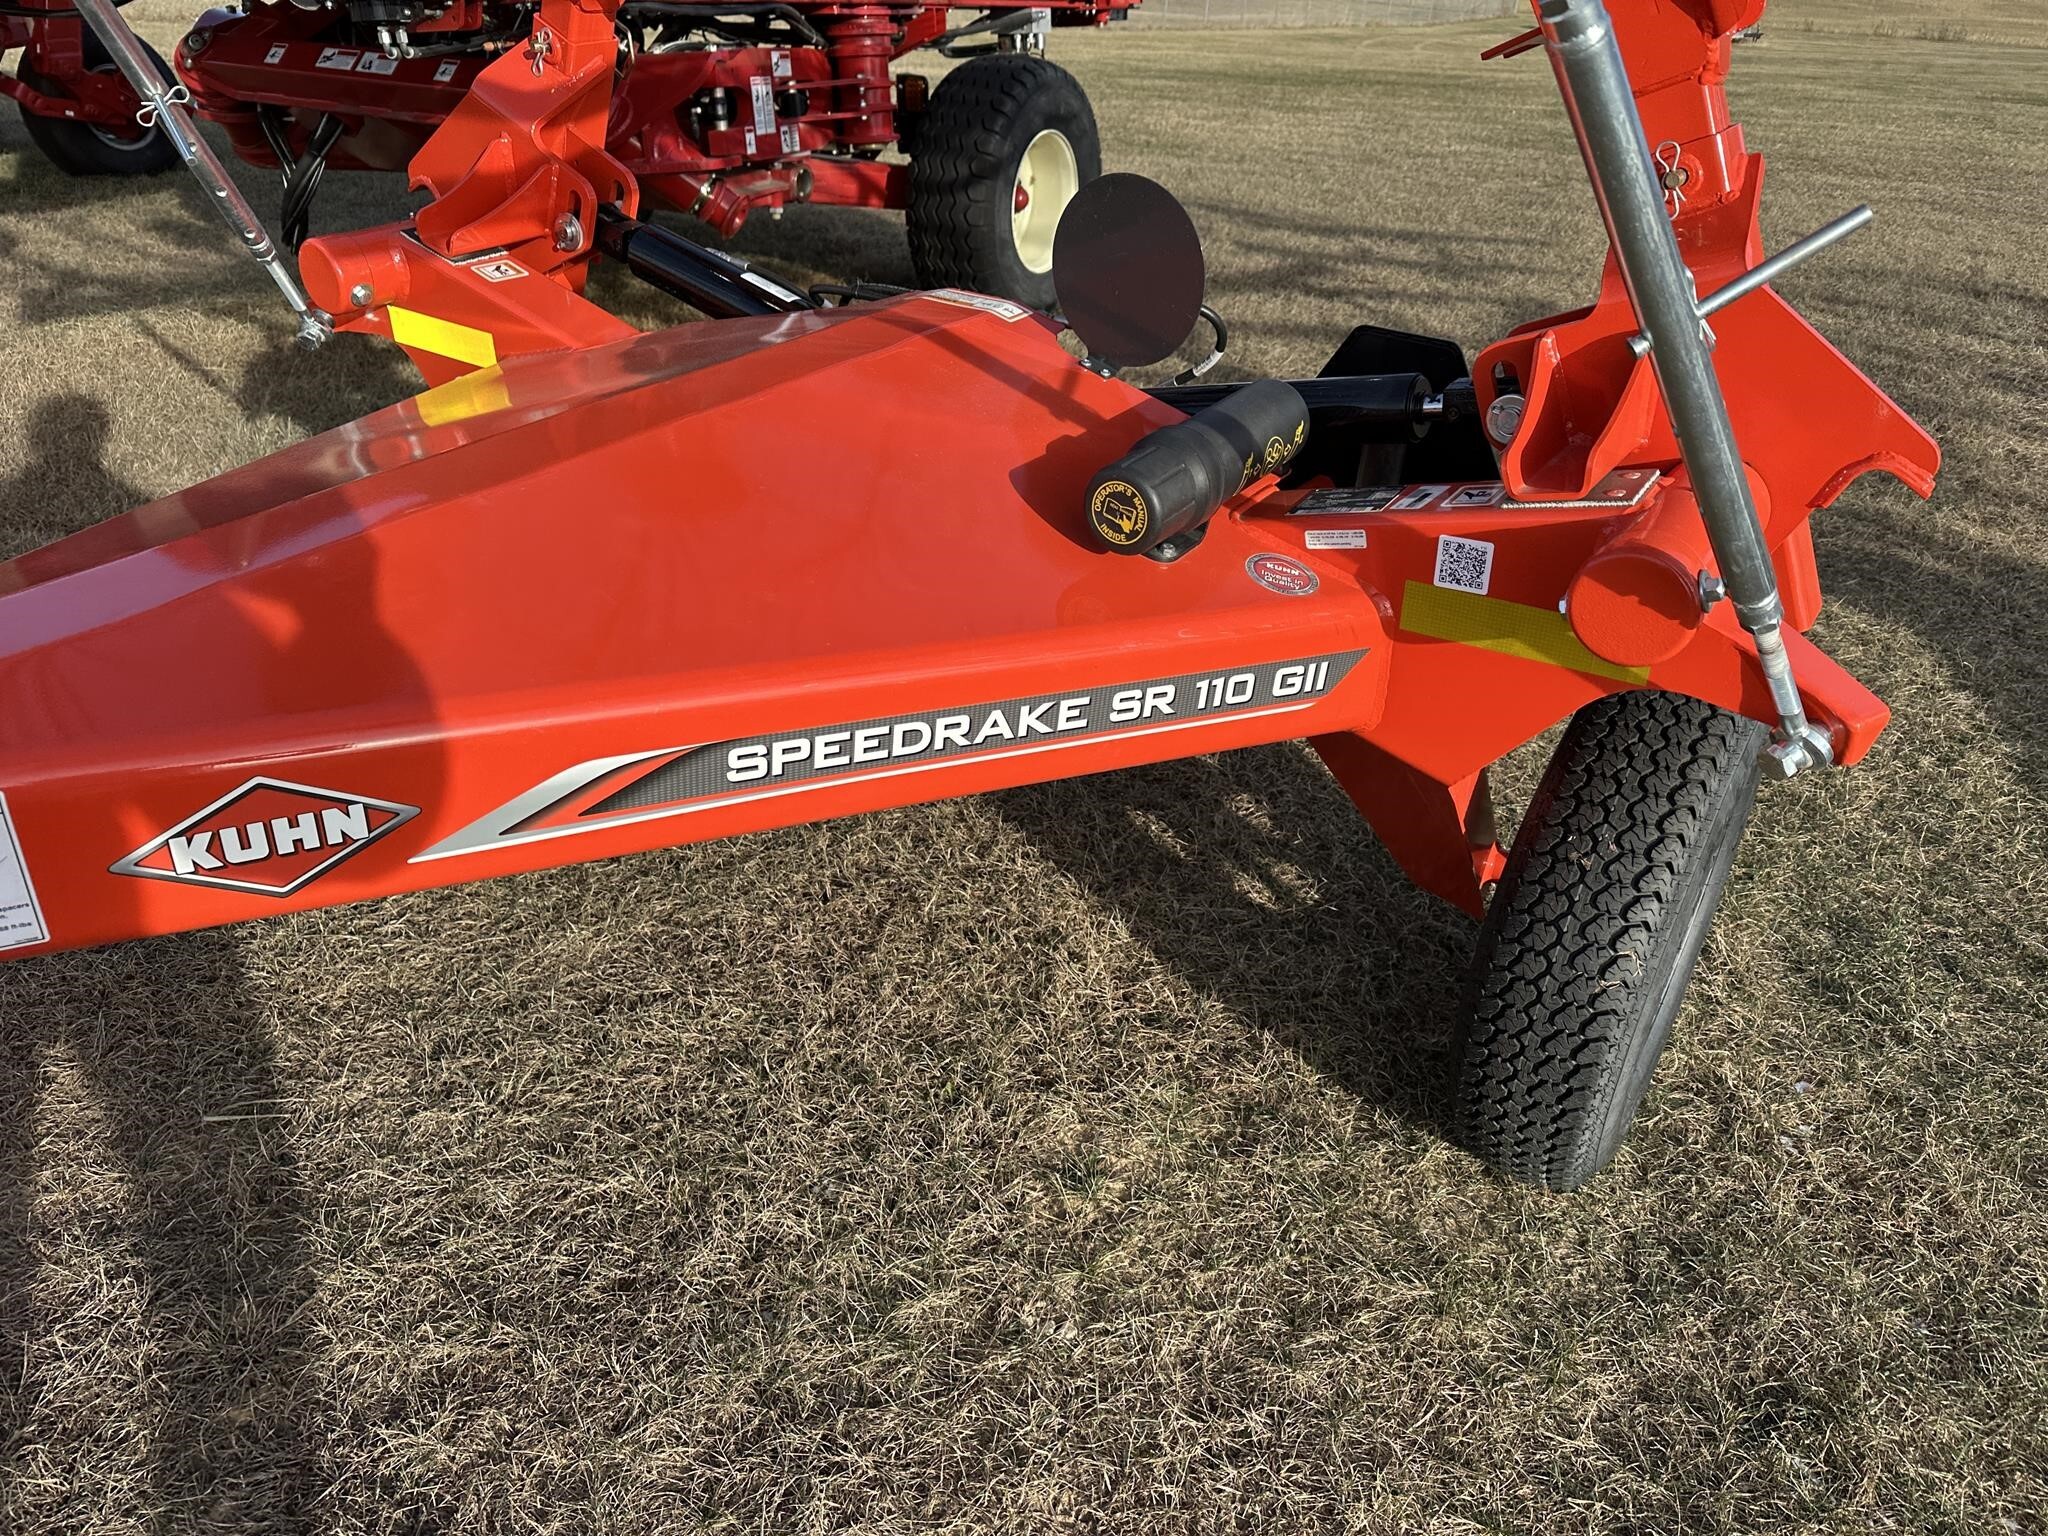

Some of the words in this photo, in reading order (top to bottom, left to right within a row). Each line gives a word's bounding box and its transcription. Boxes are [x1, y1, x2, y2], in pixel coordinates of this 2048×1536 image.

[1094, 484, 1132, 512] OPERATOR'S
[1133, 496, 1145, 532] MANUAL
[1100, 523, 1127, 541] INSIDE
[1261, 570, 1292, 583] Invest
[1295, 578, 1304, 586] in
[1266, 562, 1300, 576] KUHN
[1265, 575, 1300, 590] Quality
[726, 696, 1091, 783] SPEEDRAKE
[1109, 684, 1176, 723] SR
[1196, 673, 1256, 710] 110
[1272, 661, 1330, 697] GII
[168, 803, 369, 876] KUHN
